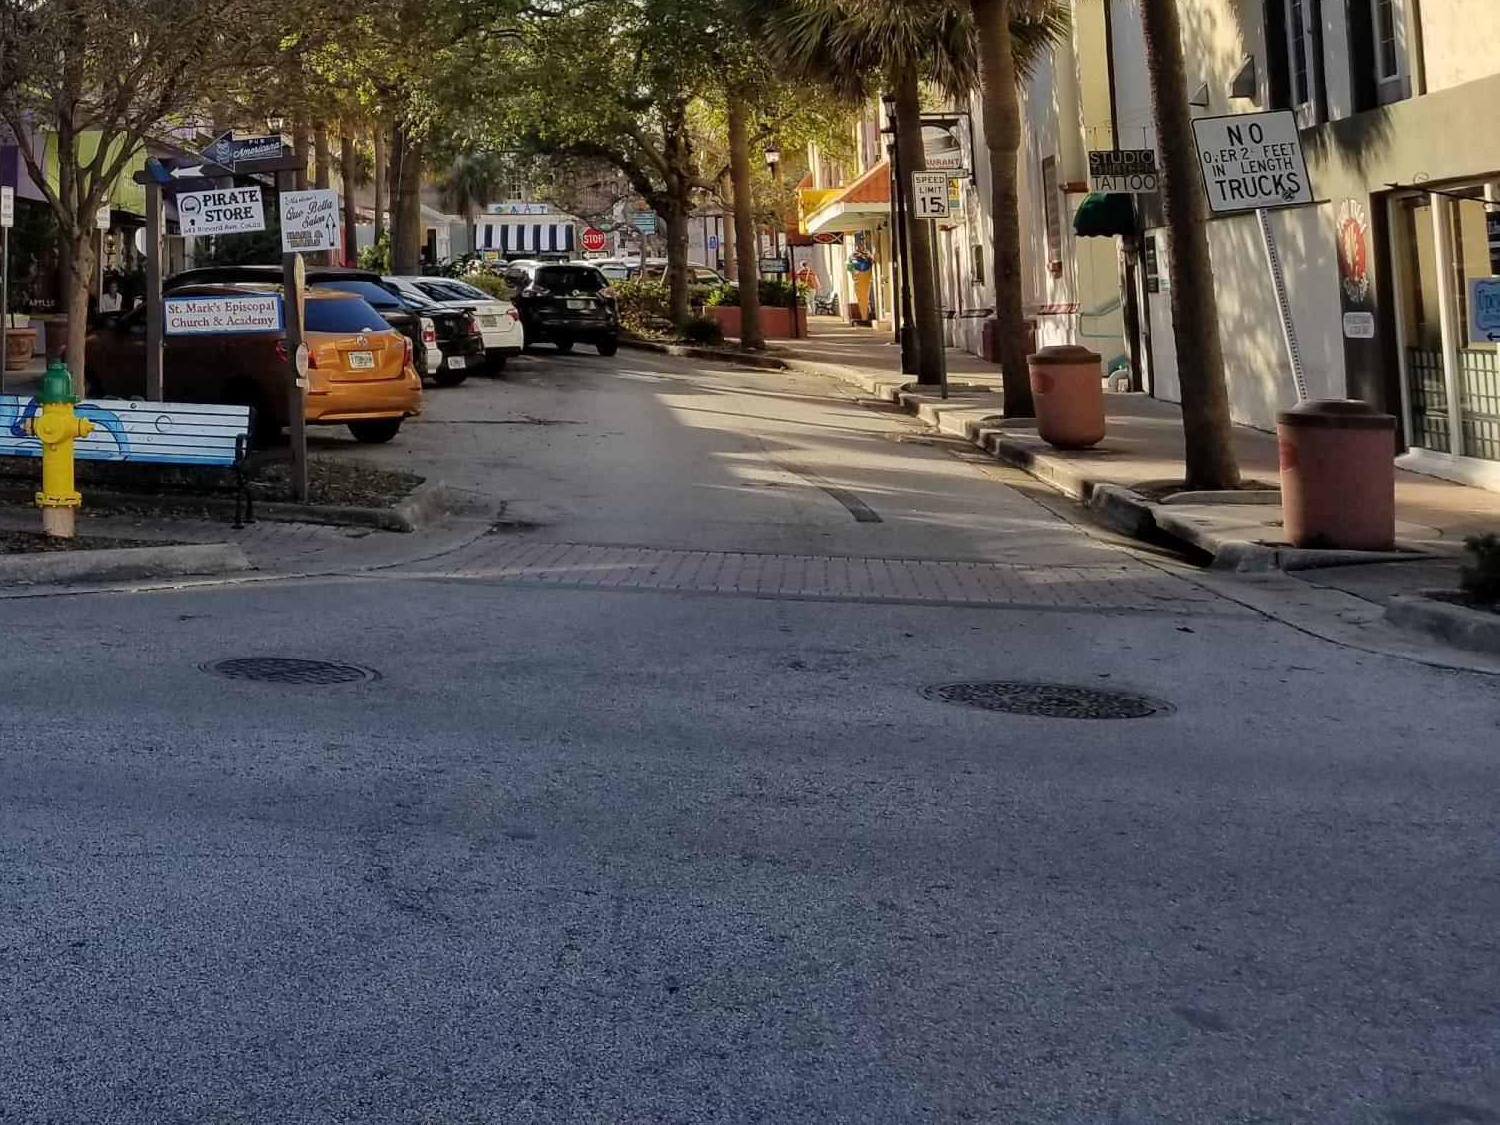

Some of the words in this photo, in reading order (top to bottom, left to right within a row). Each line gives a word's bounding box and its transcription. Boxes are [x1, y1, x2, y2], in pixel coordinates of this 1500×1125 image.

[1226, 122, 1263, 147] NO
[233, 142, 280, 158] Americana
[1090, 150, 1154, 165] STUDIO
[1203, 149, 1238, 164] OER
[1263, 142, 1296, 158] FEET
[1091, 164, 1155, 174] THIRTEEN
[1212, 164, 1226, 177] IN
[1241, 157, 1294, 174] LENGTH
[916, 176, 945, 184] SPEED
[1092, 175, 1156, 191] TATTOO
[1215, 172, 1301, 201] TRUCKS
[920, 186, 942, 194] LIMIT
[203, 190, 259, 207] PIRATE
[920, 196, 945, 213] 15
[205, 206, 254, 222] STORE
[301, 215, 325, 228] Salon
[583, 235, 604, 244] STOP
[168, 304, 183, 314] St.
[186, 303, 221, 313] Mark's
[225, 300, 275, 315] Episcopal
[171, 317, 210, 328] Church
[213, 316, 223, 326] &
[227, 315, 274, 327] Academy
